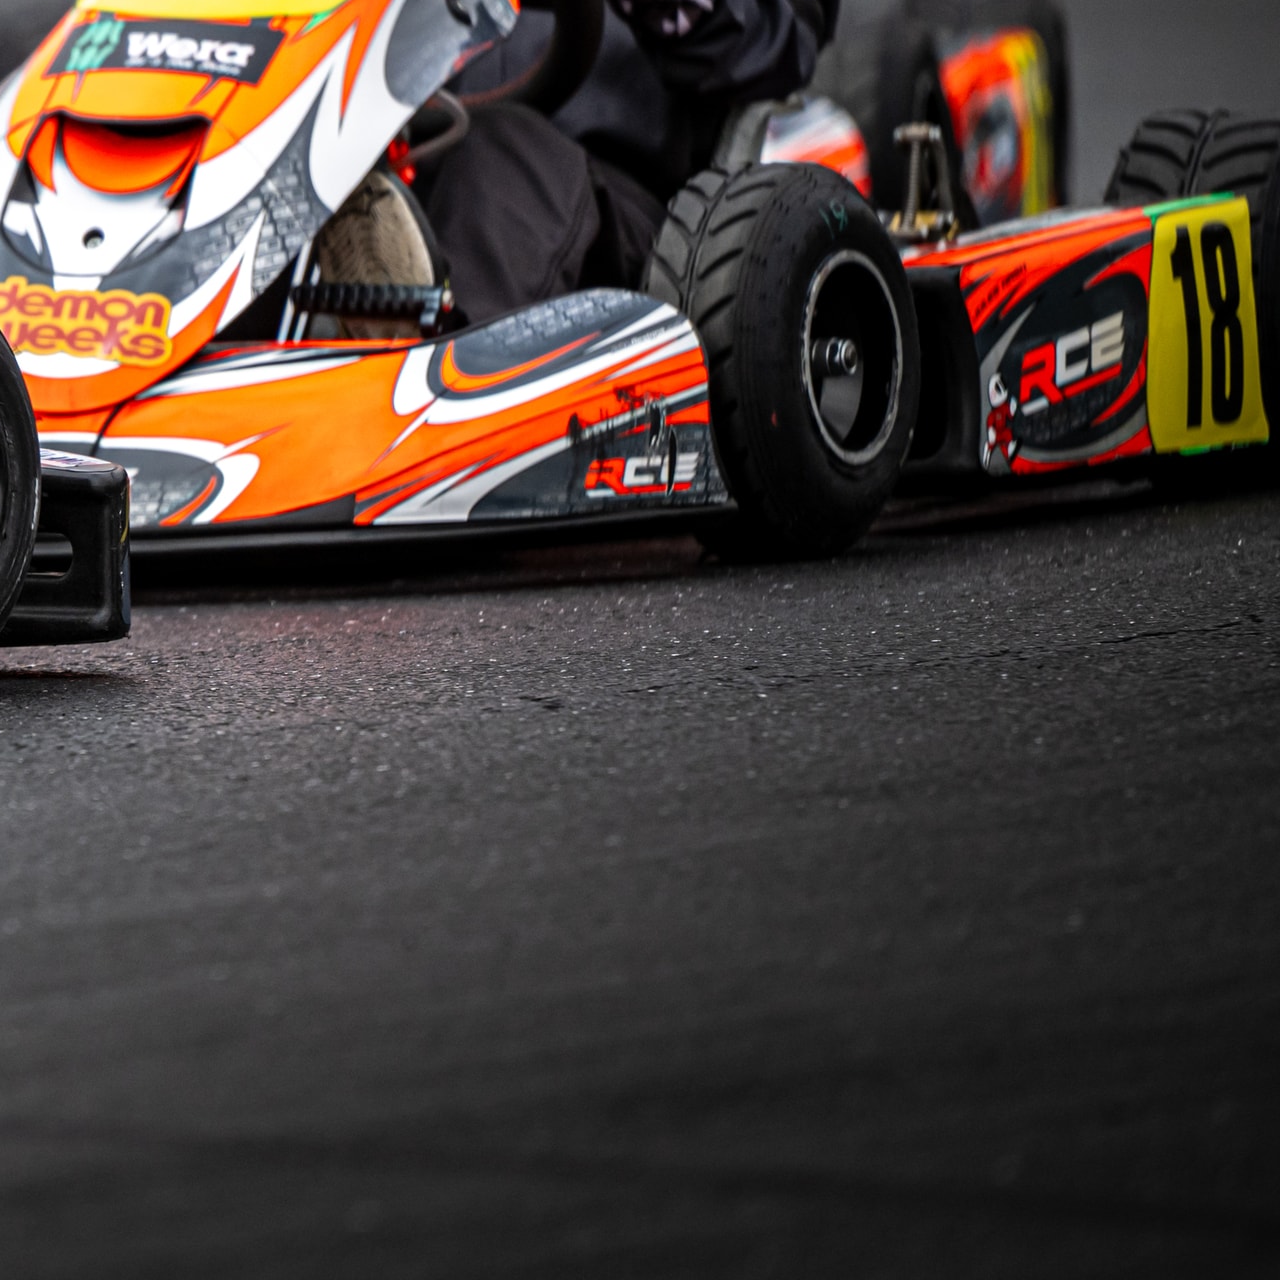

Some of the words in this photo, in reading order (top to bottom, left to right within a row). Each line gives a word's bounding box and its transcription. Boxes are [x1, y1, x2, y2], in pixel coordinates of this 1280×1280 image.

[3, 319, 165, 360] weeks
[1019, 310, 1125, 406] RCE
[1170, 220, 1246, 431] 18
